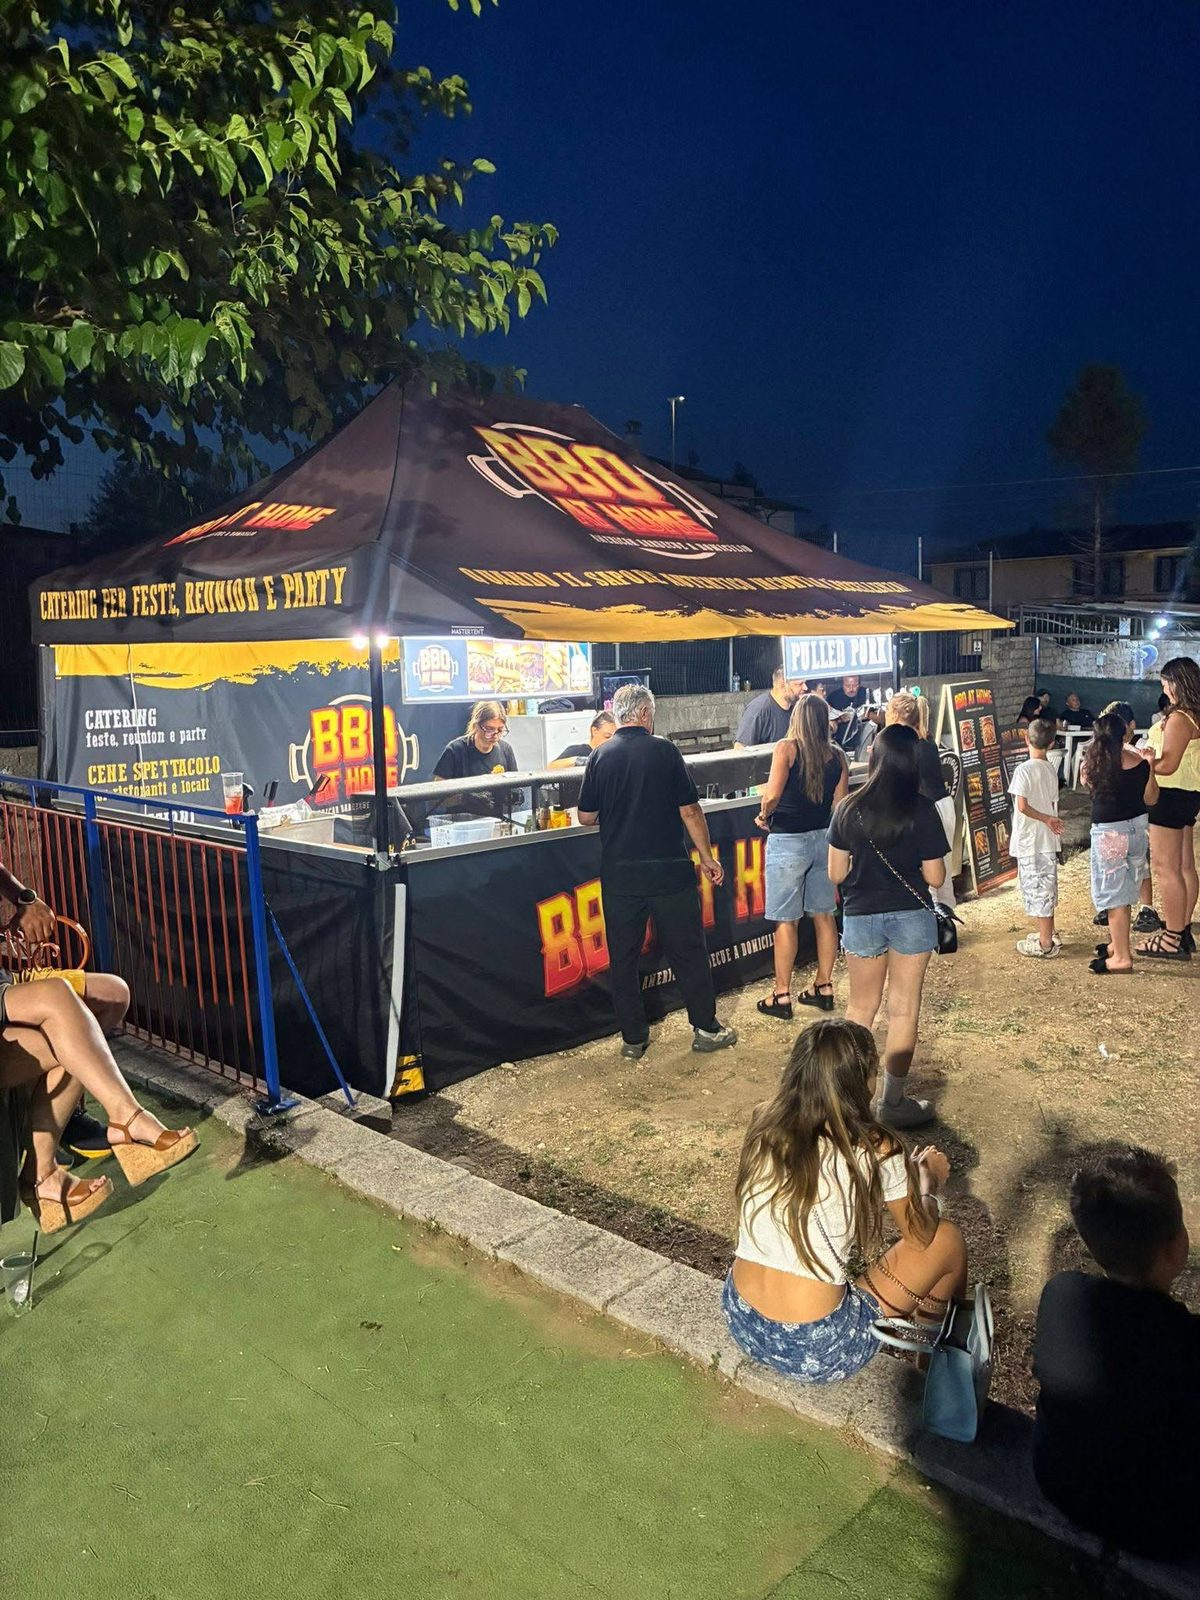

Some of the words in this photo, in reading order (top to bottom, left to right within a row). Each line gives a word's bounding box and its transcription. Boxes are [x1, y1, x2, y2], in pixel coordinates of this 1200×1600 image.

[472, 426, 674, 508] BBQ
[241, 503, 337, 531] HOME
[552, 496, 626, 535] AT
[591, 500, 719, 542] HOME
[458, 567, 560, 587] QUANDO
[553, 572, 592, 587] IL
[584, 569, 669, 587] SAPORE
[40, 589, 98, 620] CATERING
[101, 587, 127, 618] PER
[132, 582, 180, 616] FESTE,
[185, 577, 259, 614] REUNION
[265, 575, 277, 610] E
[281, 567, 346, 609] PARTY
[451, 627, 484, 635] MASTERTENT
[790, 639, 846, 672] PULLED
[850, 637, 888, 666] PORK
[85, 708, 157, 730] CATERING
[86, 731, 119, 747] feste,
[123, 730, 165, 746] reunion
[170, 731, 175, 742] e
[179, 727, 207, 745] party
[88, 763, 128, 785] CENE
[133, 756, 221, 781] SPETTACOLO
[172, 782, 178, 794] e
[181, 777, 211, 793] locali
[345, 764, 399, 797] HOE
[536, 877, 611, 997] BB
[642, 967, 674, 990] AMERI
[710, 947, 732, 968] ECUE
[733, 944, 740, 959] A
[741, 932, 776, 956] DOMICIL
